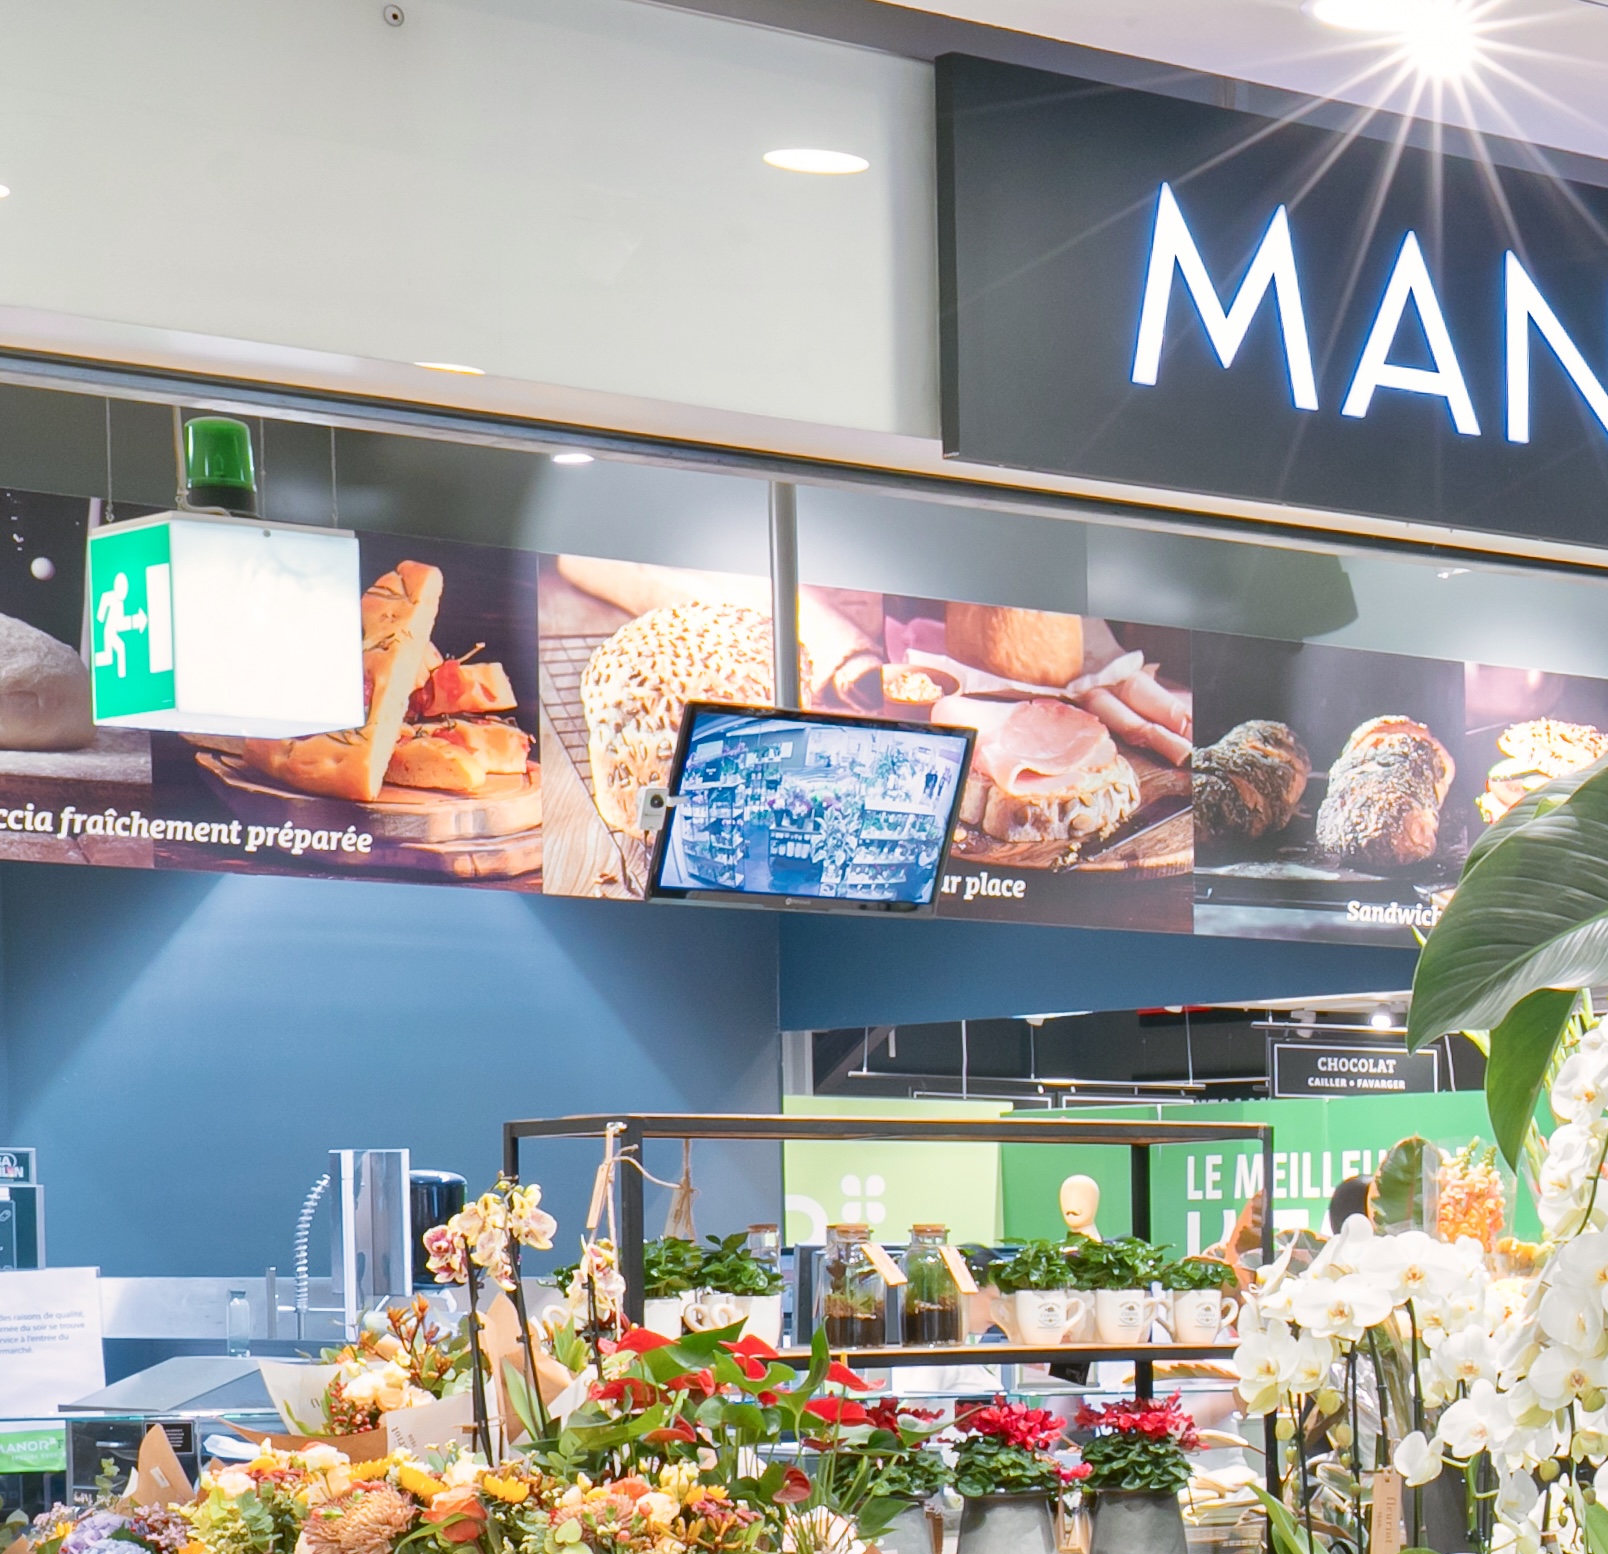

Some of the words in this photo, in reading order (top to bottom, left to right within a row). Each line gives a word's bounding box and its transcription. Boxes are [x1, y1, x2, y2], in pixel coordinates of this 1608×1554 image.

[57, 806, 242, 846] fraîchement
[244, 820, 375, 856] préparée
[963, 871, 1027, 901] place
[1317, 1056, 1397, 1074] CHOCOLAT
[1307, 1076, 1348, 1088] CAILLER
[1356, 1078, 1406, 1090] FAVARGER
[1187, 1154, 1223, 1200] LE
